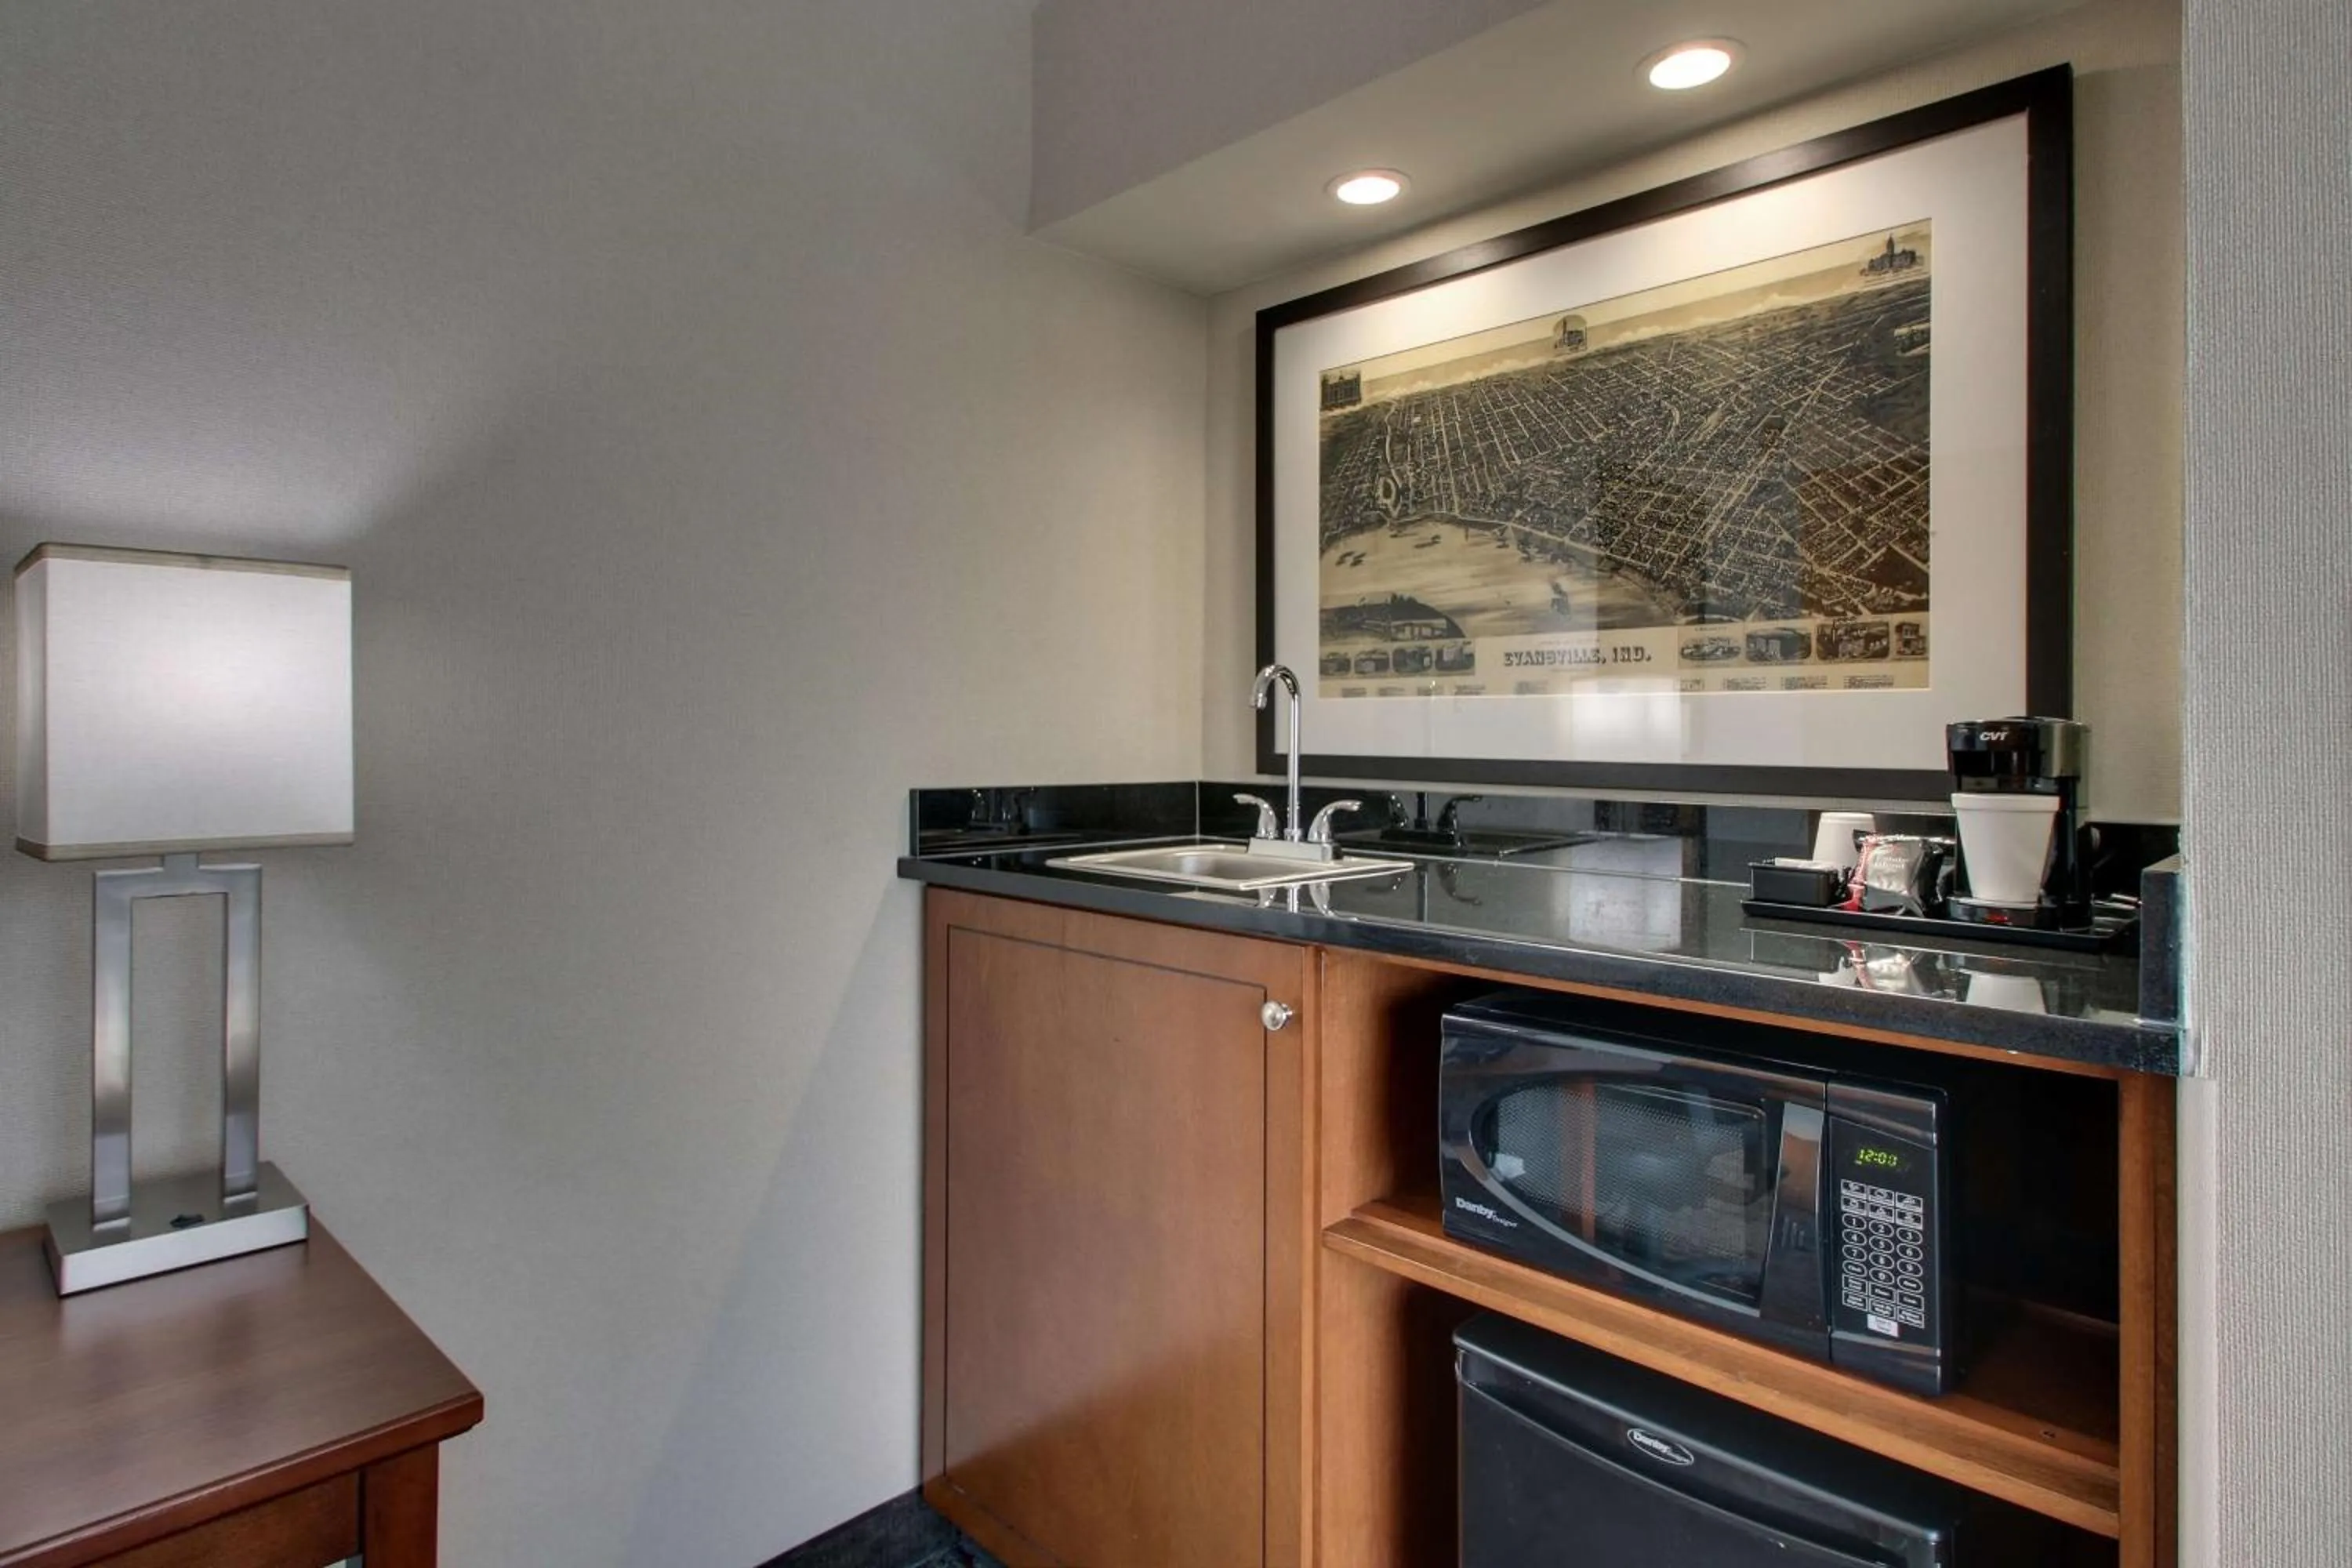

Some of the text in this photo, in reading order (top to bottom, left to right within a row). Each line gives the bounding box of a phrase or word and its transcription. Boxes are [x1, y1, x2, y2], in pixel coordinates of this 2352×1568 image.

[1504, 646, 1651, 666] EVANSVILLE, IND.
[1980, 731, 2009, 741] CVT
[1455, 1196, 1494, 1219] Danby
